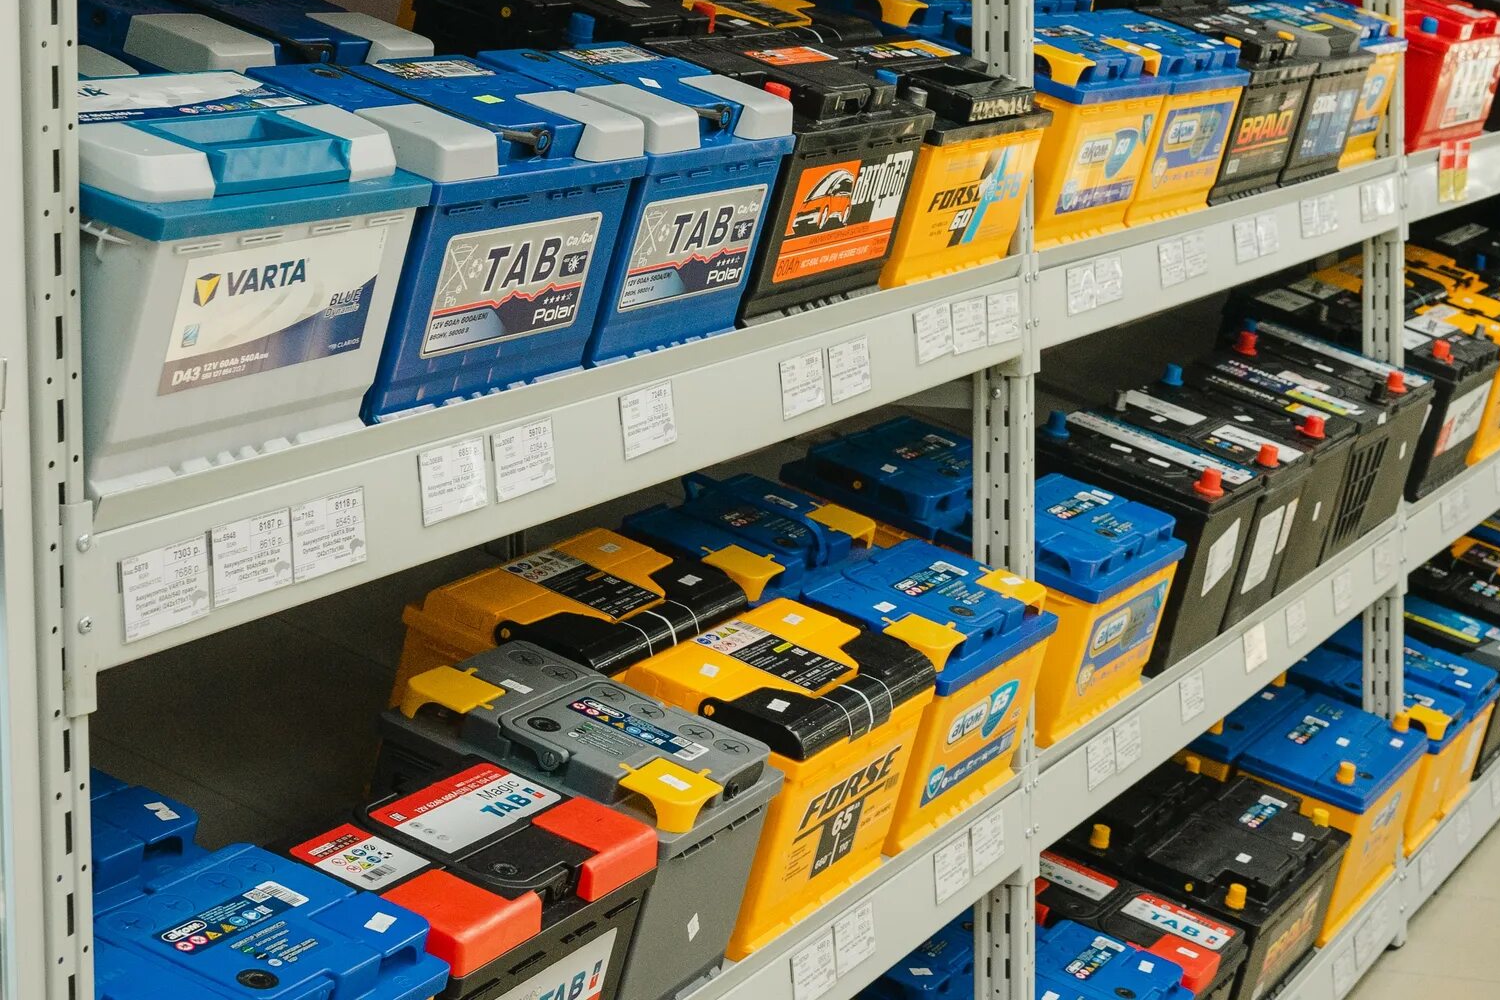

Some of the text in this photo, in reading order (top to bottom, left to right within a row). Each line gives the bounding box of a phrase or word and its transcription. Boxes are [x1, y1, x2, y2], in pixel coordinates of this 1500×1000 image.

[1237, 109, 1295, 146] BRAVO
[738, 201, 760, 214] Ca/Ca
[950, 206, 973, 231] 60
[566, 231, 594, 247] Ca/Ca
[668, 205, 735, 257] TAB
[483, 237, 563, 293] TAB
[706, 266, 742, 285] Polar
[227, 258, 306, 297] VARTA
[328, 286, 363, 308] BLUE
[323, 302, 361, 319] Dynamic
[531, 303, 576, 325] Polar
[336, 337, 360, 350] CLARIOS
[203, 357, 240, 372] 12V 60Ah
[171, 366, 201, 387] D43
[173, 547, 192, 560] 7303
[990, 686, 1013, 715] 65
[475, 779, 521, 801] Magic
[797, 743, 904, 833] FORSE
[413, 805, 426, 815] 12V
[479, 792, 533, 818] TAB
[831, 809, 854, 837] 65
[1149, 908, 1202, 939] TAB
